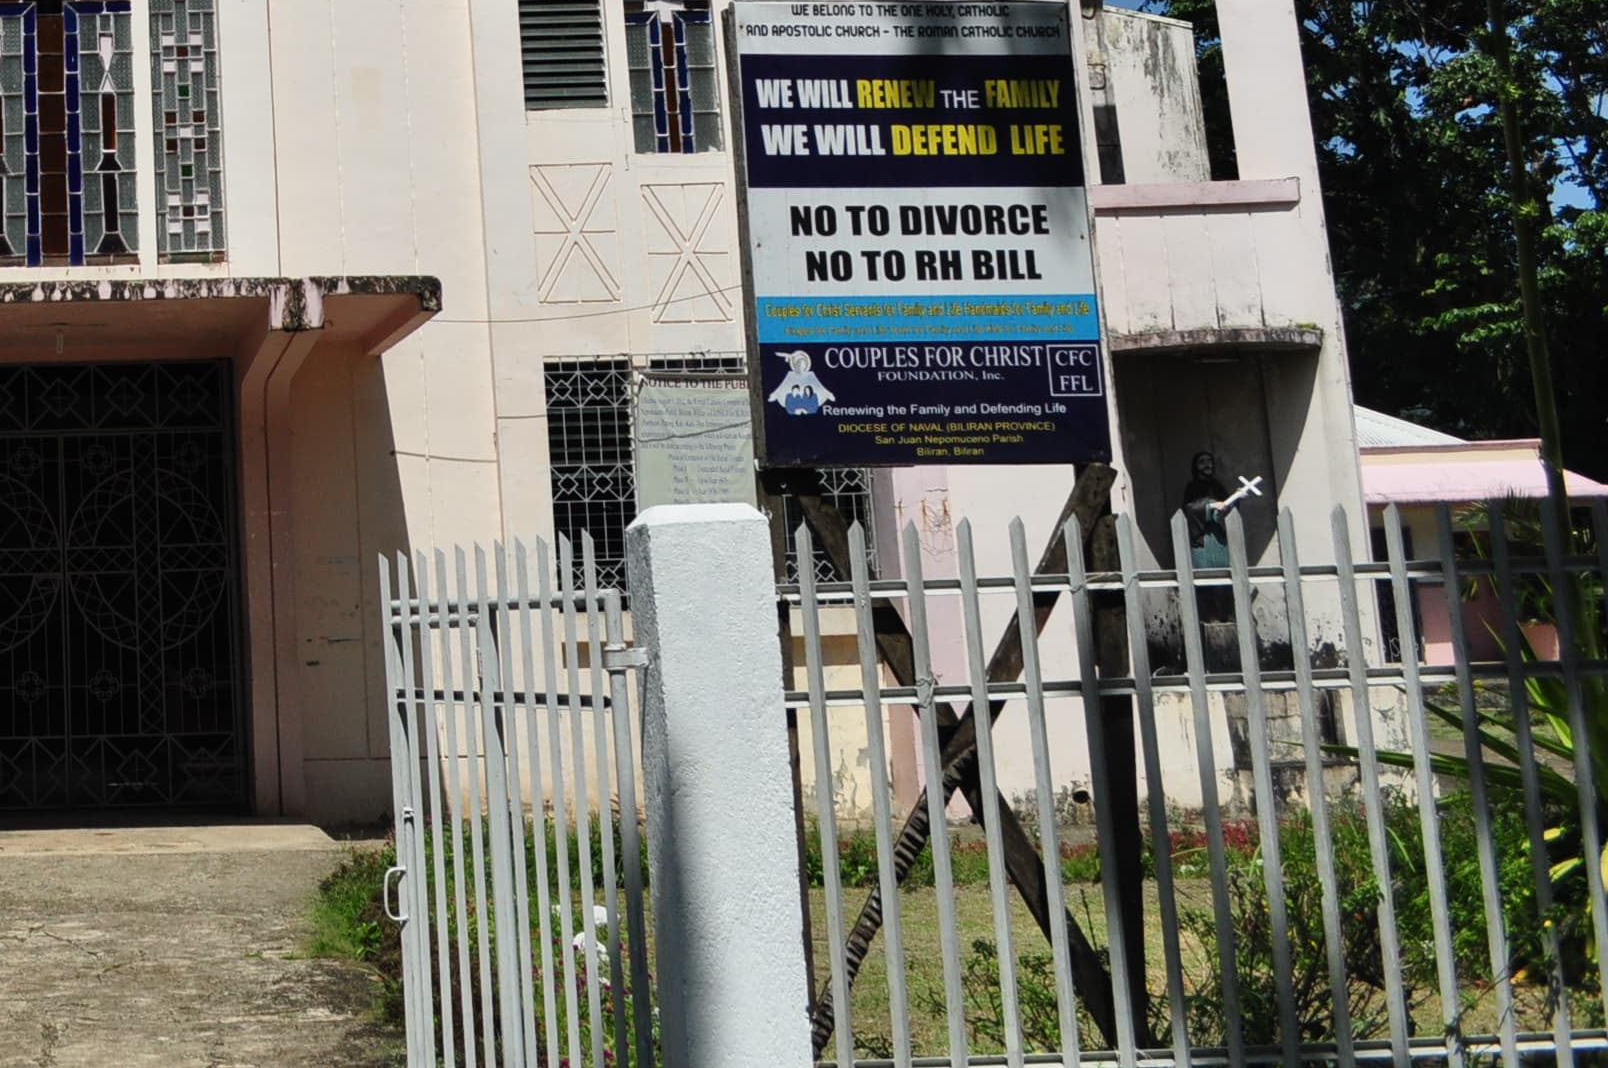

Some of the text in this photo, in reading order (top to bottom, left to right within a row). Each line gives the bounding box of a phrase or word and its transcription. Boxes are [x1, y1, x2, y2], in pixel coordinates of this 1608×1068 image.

[791, 4, 1010, 19] WE BELONG TO THE ONE HOLY, CATHOLIC
[745, 24, 769, 37] AND
[771, 24, 832, 38] APOSTOLIC
[835, 24, 881, 38] CHURCH
[893, 25, 915, 38] THE
[917, 25, 959, 38] ROMAN
[960, 25, 1013, 38] CATHOLIC
[1015, 25, 1061, 38] CHURCH
[755, 79, 1060, 109] WE WILL RENEW THE FAMILY
[761, 124, 1065, 156] WE WILL DEFEND LIFE
[790, 204, 1050, 236] NO TO DIVORCE
[805, 249, 1042, 281] NO TO RH BILL
[765, 303, 800, 319] Couples
[801, 303, 813, 316] for
[816, 303, 841, 316] Christ
[844, 303, 881, 316] Servants
[883, 303, 894, 316] for
[897, 302, 925, 319] Family
[928, 302, 942, 316] and
[947, 301, 961, 315] Life
[1026, 301, 1053, 317] Family
[1056, 301, 1072, 315] and
[1075, 301, 1090, 315] Life
[825, 345, 1044, 368] COUPLES FOR CHRIST
[1055, 350, 1092, 366] CFC
[982, 370, 1005, 380] Inc.
[641, 378, 681, 389] NOTICE
[684, 378, 699, 389] TO
[701, 378, 722, 389] THE
[1059, 375, 1093, 391] FFL
[822, 403, 1067, 417] Renewing the Family and Defending Life
[838, 422, 1055, 433] DIOCESE OF NAVAL (BILIRAN PROVINCE)
[875, 434, 1024, 445] San Juan Nepomuceno Parish
[917, 446, 984, 457] Biliran, Biliran
